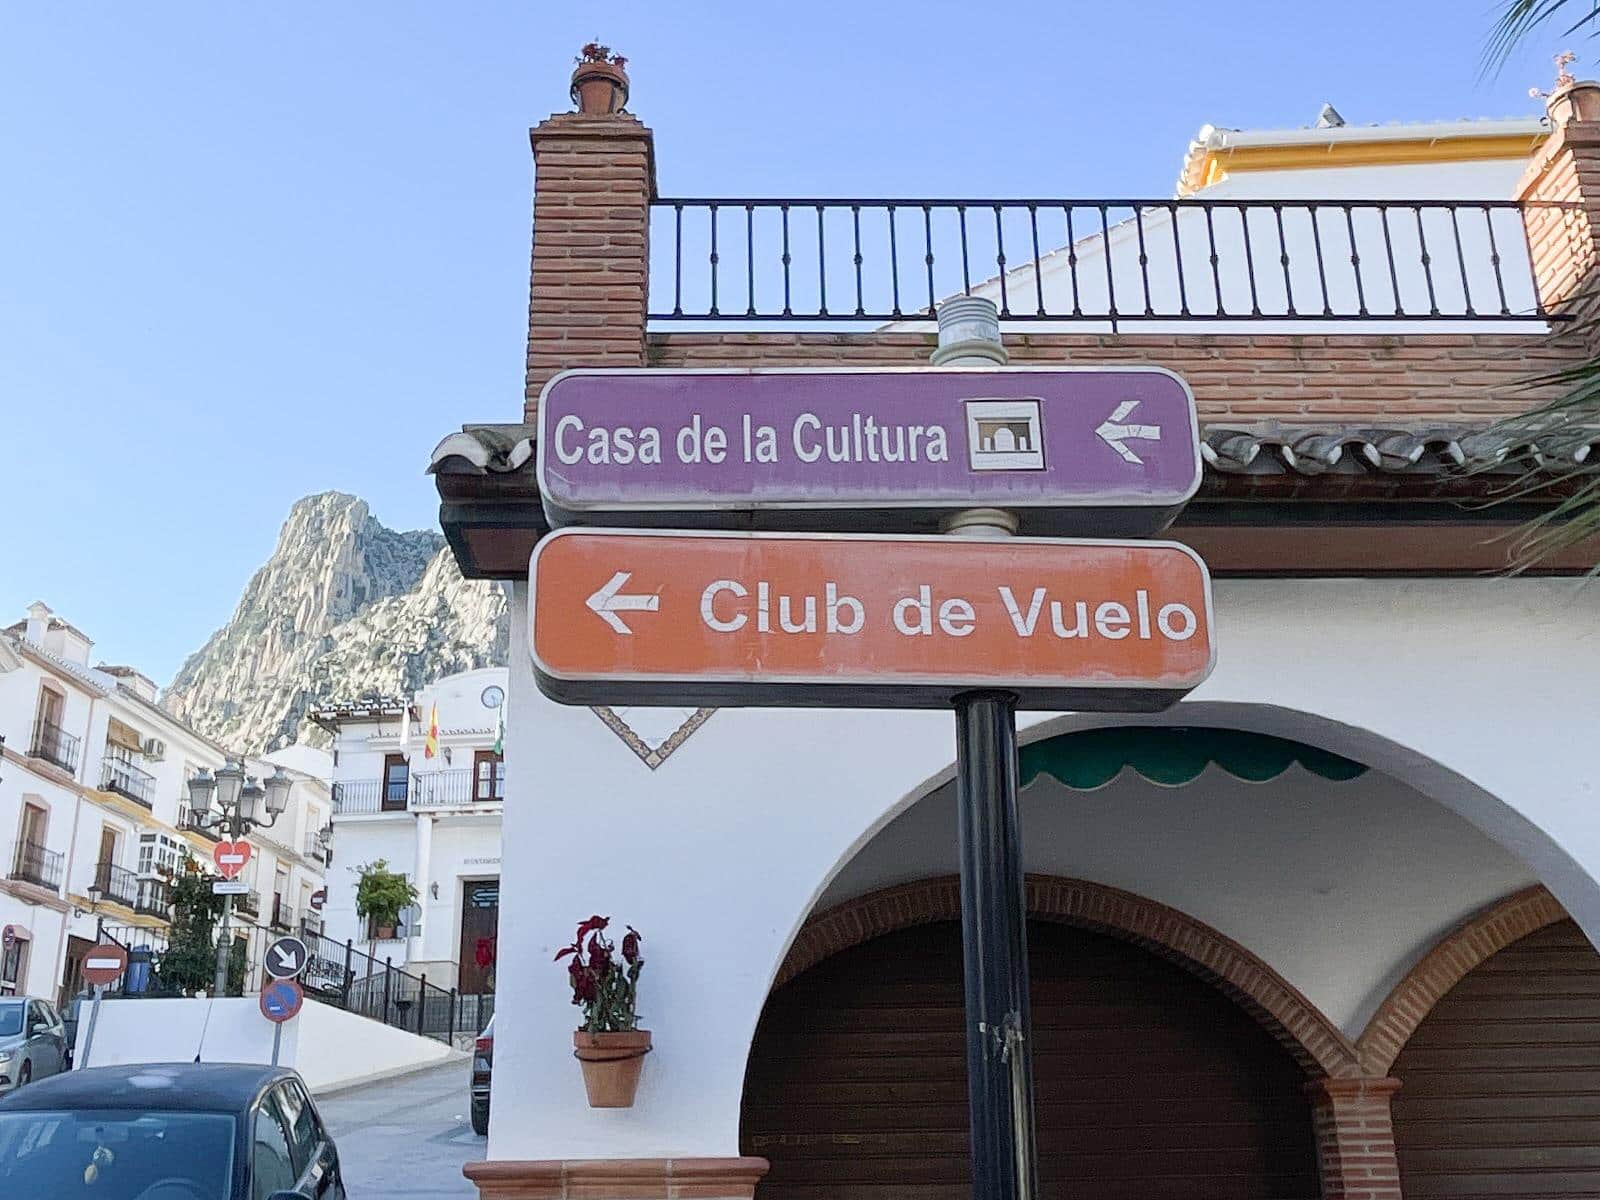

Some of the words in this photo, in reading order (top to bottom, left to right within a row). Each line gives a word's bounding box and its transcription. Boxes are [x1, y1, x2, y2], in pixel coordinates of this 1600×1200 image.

[554, 414, 663, 466] Casa
[676, 414, 729, 465] de
[742, 414, 780, 464] la
[792, 411, 950, 464] Cultura
[700, 579, 867, 635] Club
[892, 584, 977, 637] de
[997, 586, 1198, 642] Vuelo
